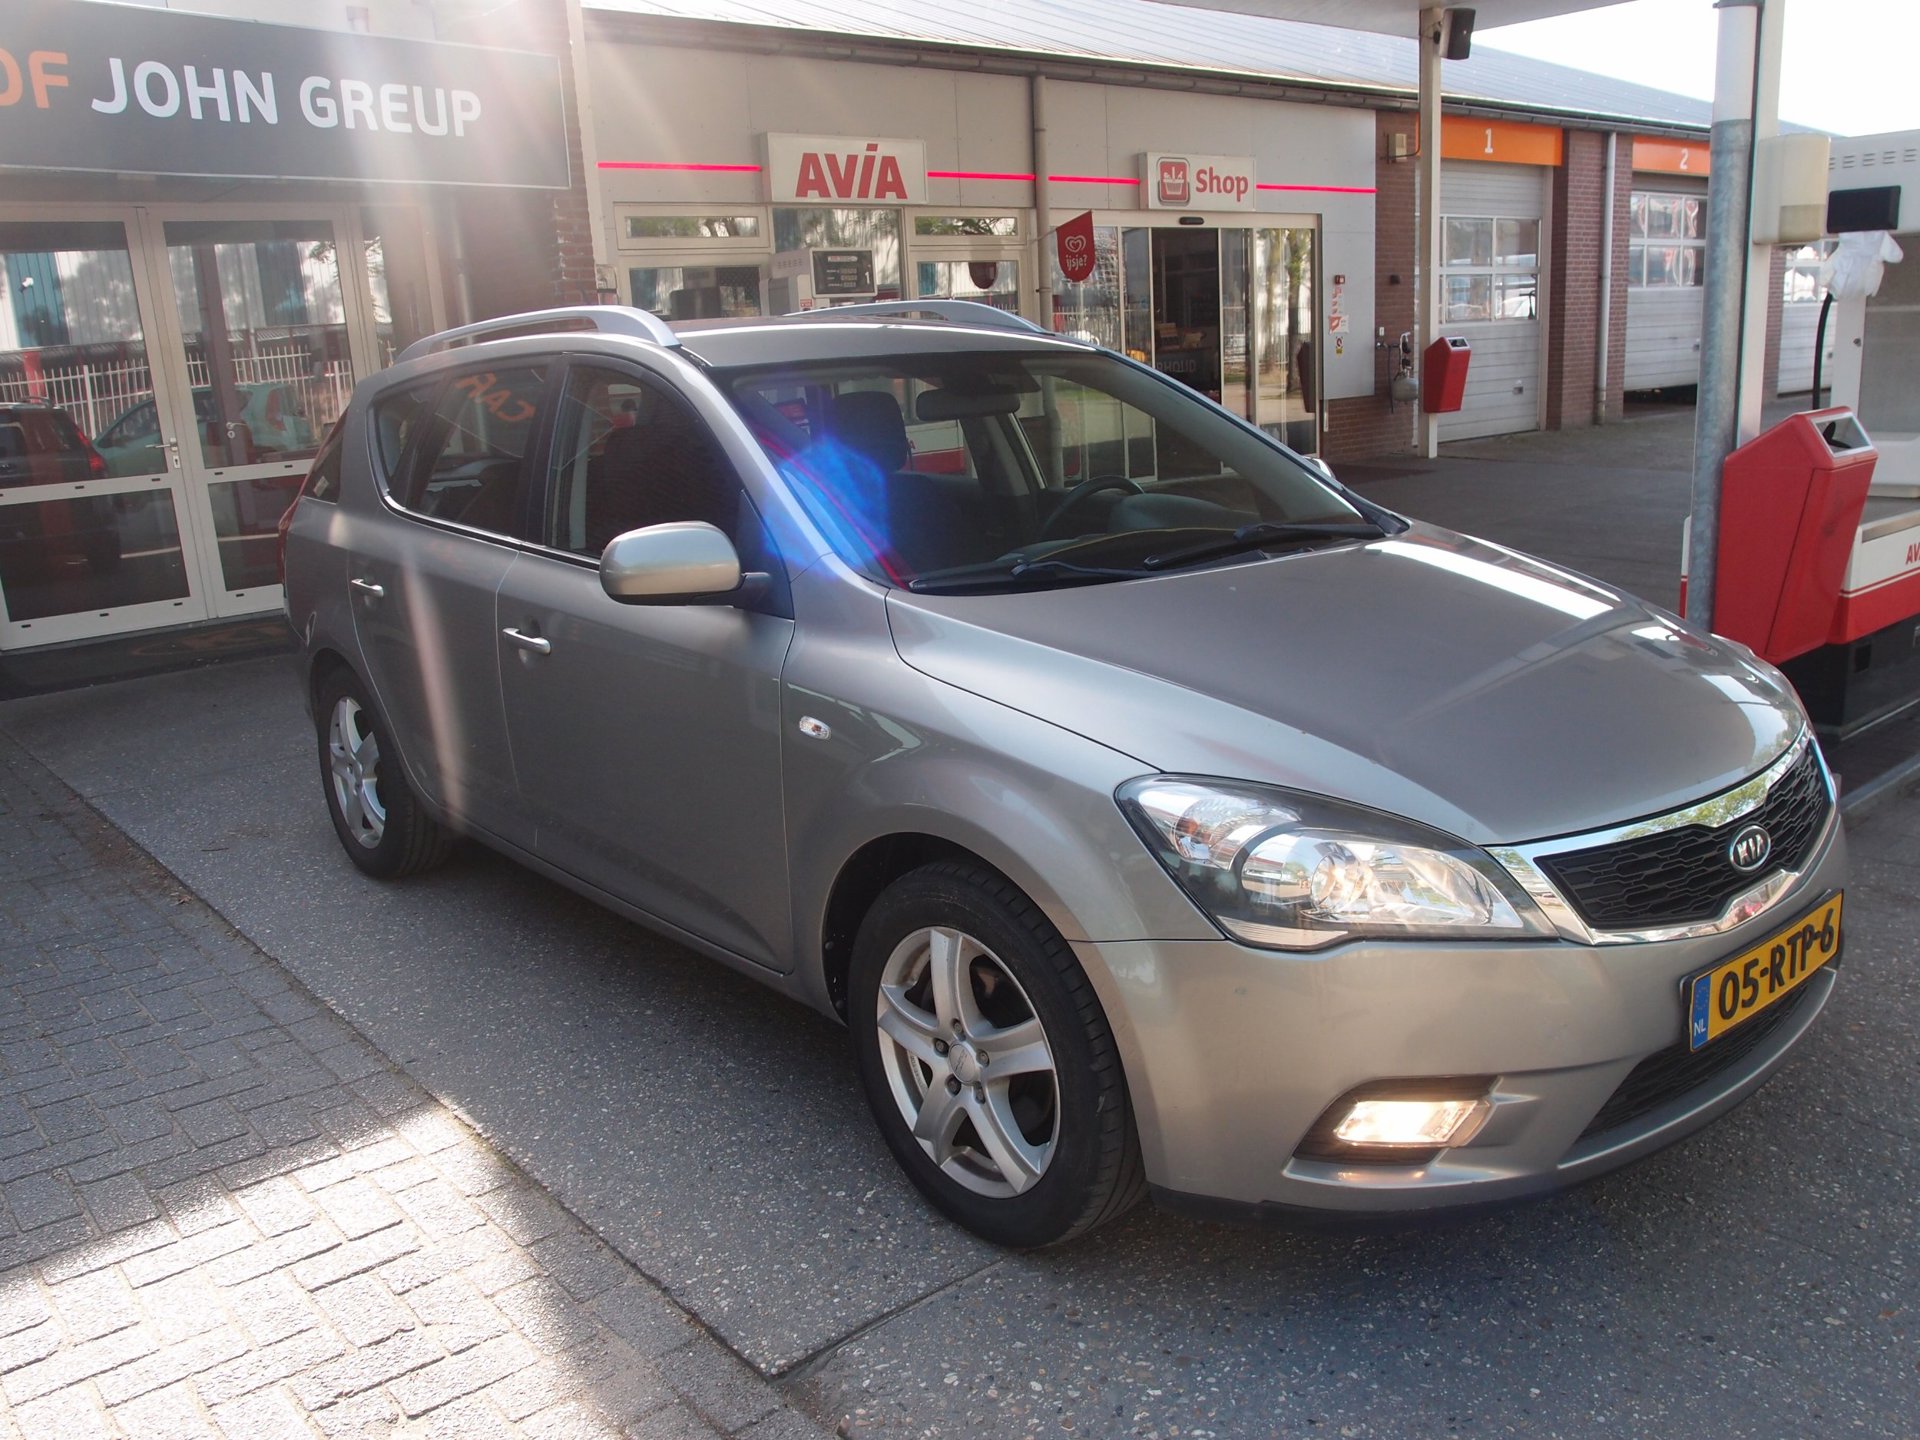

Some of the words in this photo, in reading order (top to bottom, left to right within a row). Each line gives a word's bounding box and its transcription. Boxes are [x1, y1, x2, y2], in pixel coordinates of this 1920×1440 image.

[91, 57, 278, 125] JOHN
[299, 75, 482, 138] GREUP
[1484, 128, 1493, 154] 1
[1680, 149, 1689, 170] 2
[1195, 166, 1249, 203] Shop
[1065, 254, 1088, 272] ijsje?
[1736, 834, 1765, 865] KIA
[1718, 908, 1835, 1021] 05-RTP-6
[1693, 1018, 1707, 1037] NL
